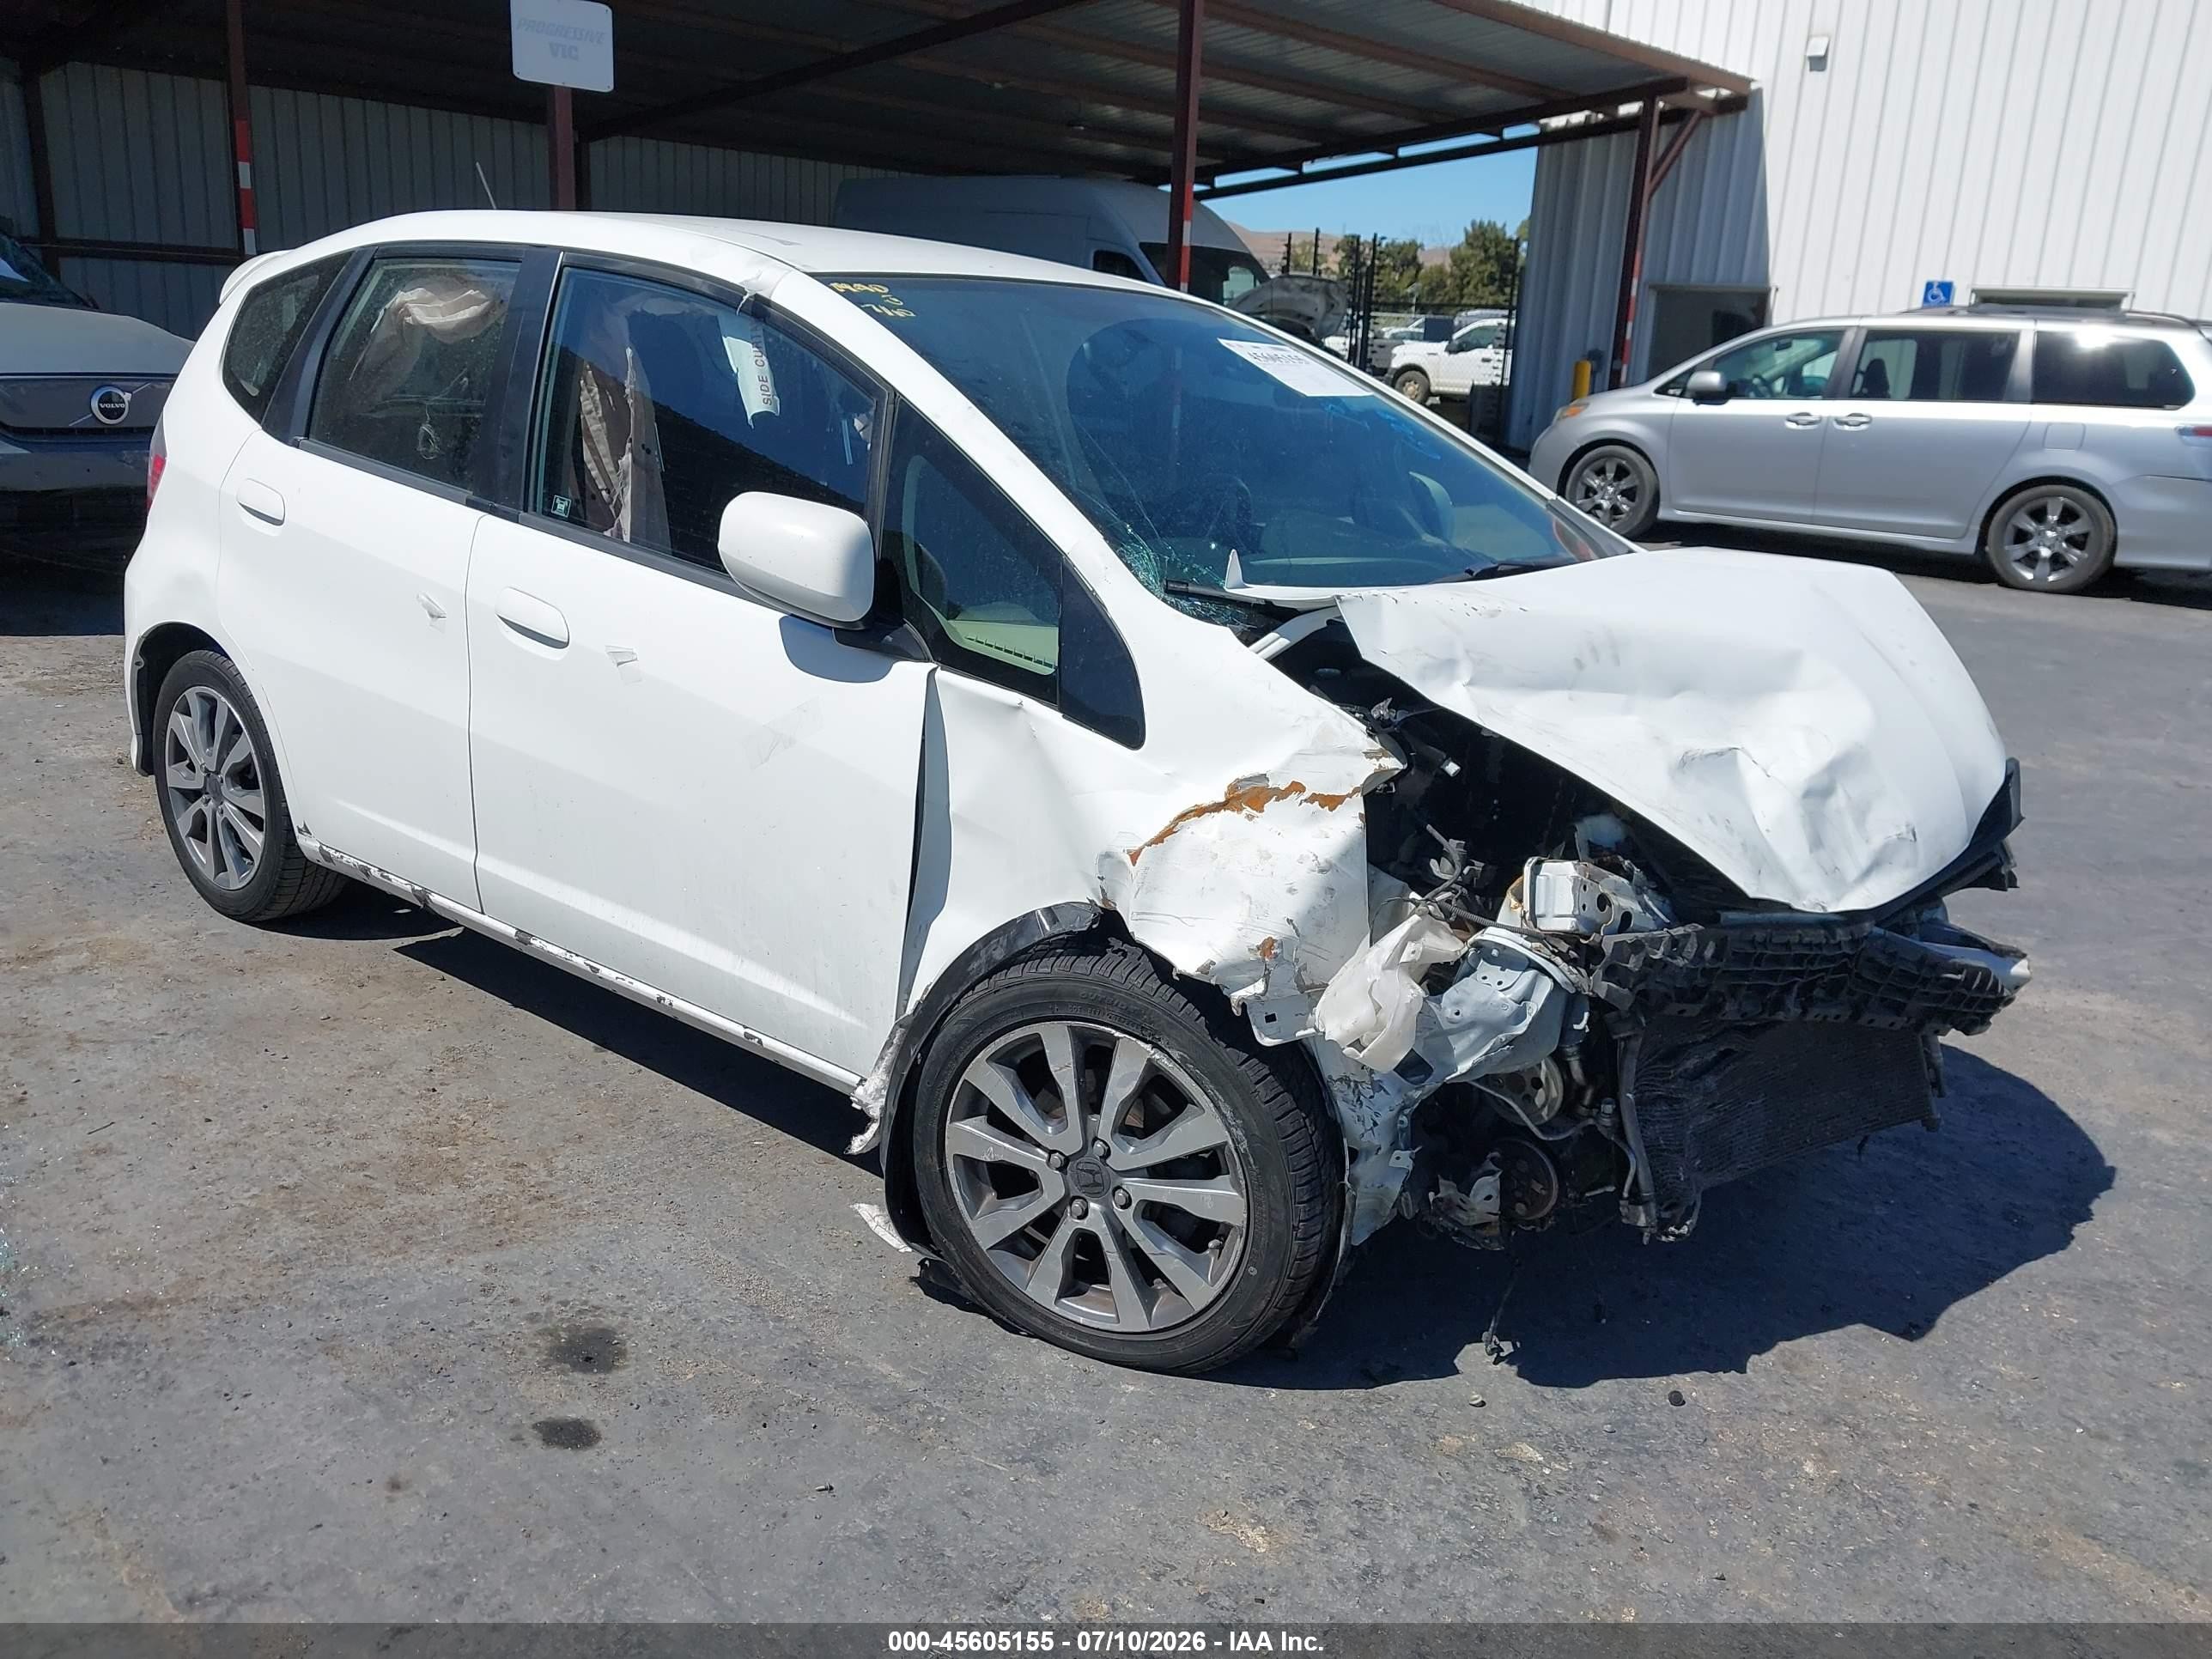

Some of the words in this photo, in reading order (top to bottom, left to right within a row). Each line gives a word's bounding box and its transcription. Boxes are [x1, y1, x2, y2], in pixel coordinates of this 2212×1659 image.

[516, 17, 606, 46] PROGRESSIVE
[549, 41, 579, 61] VIC
[757, 374, 773, 406] SIDE
